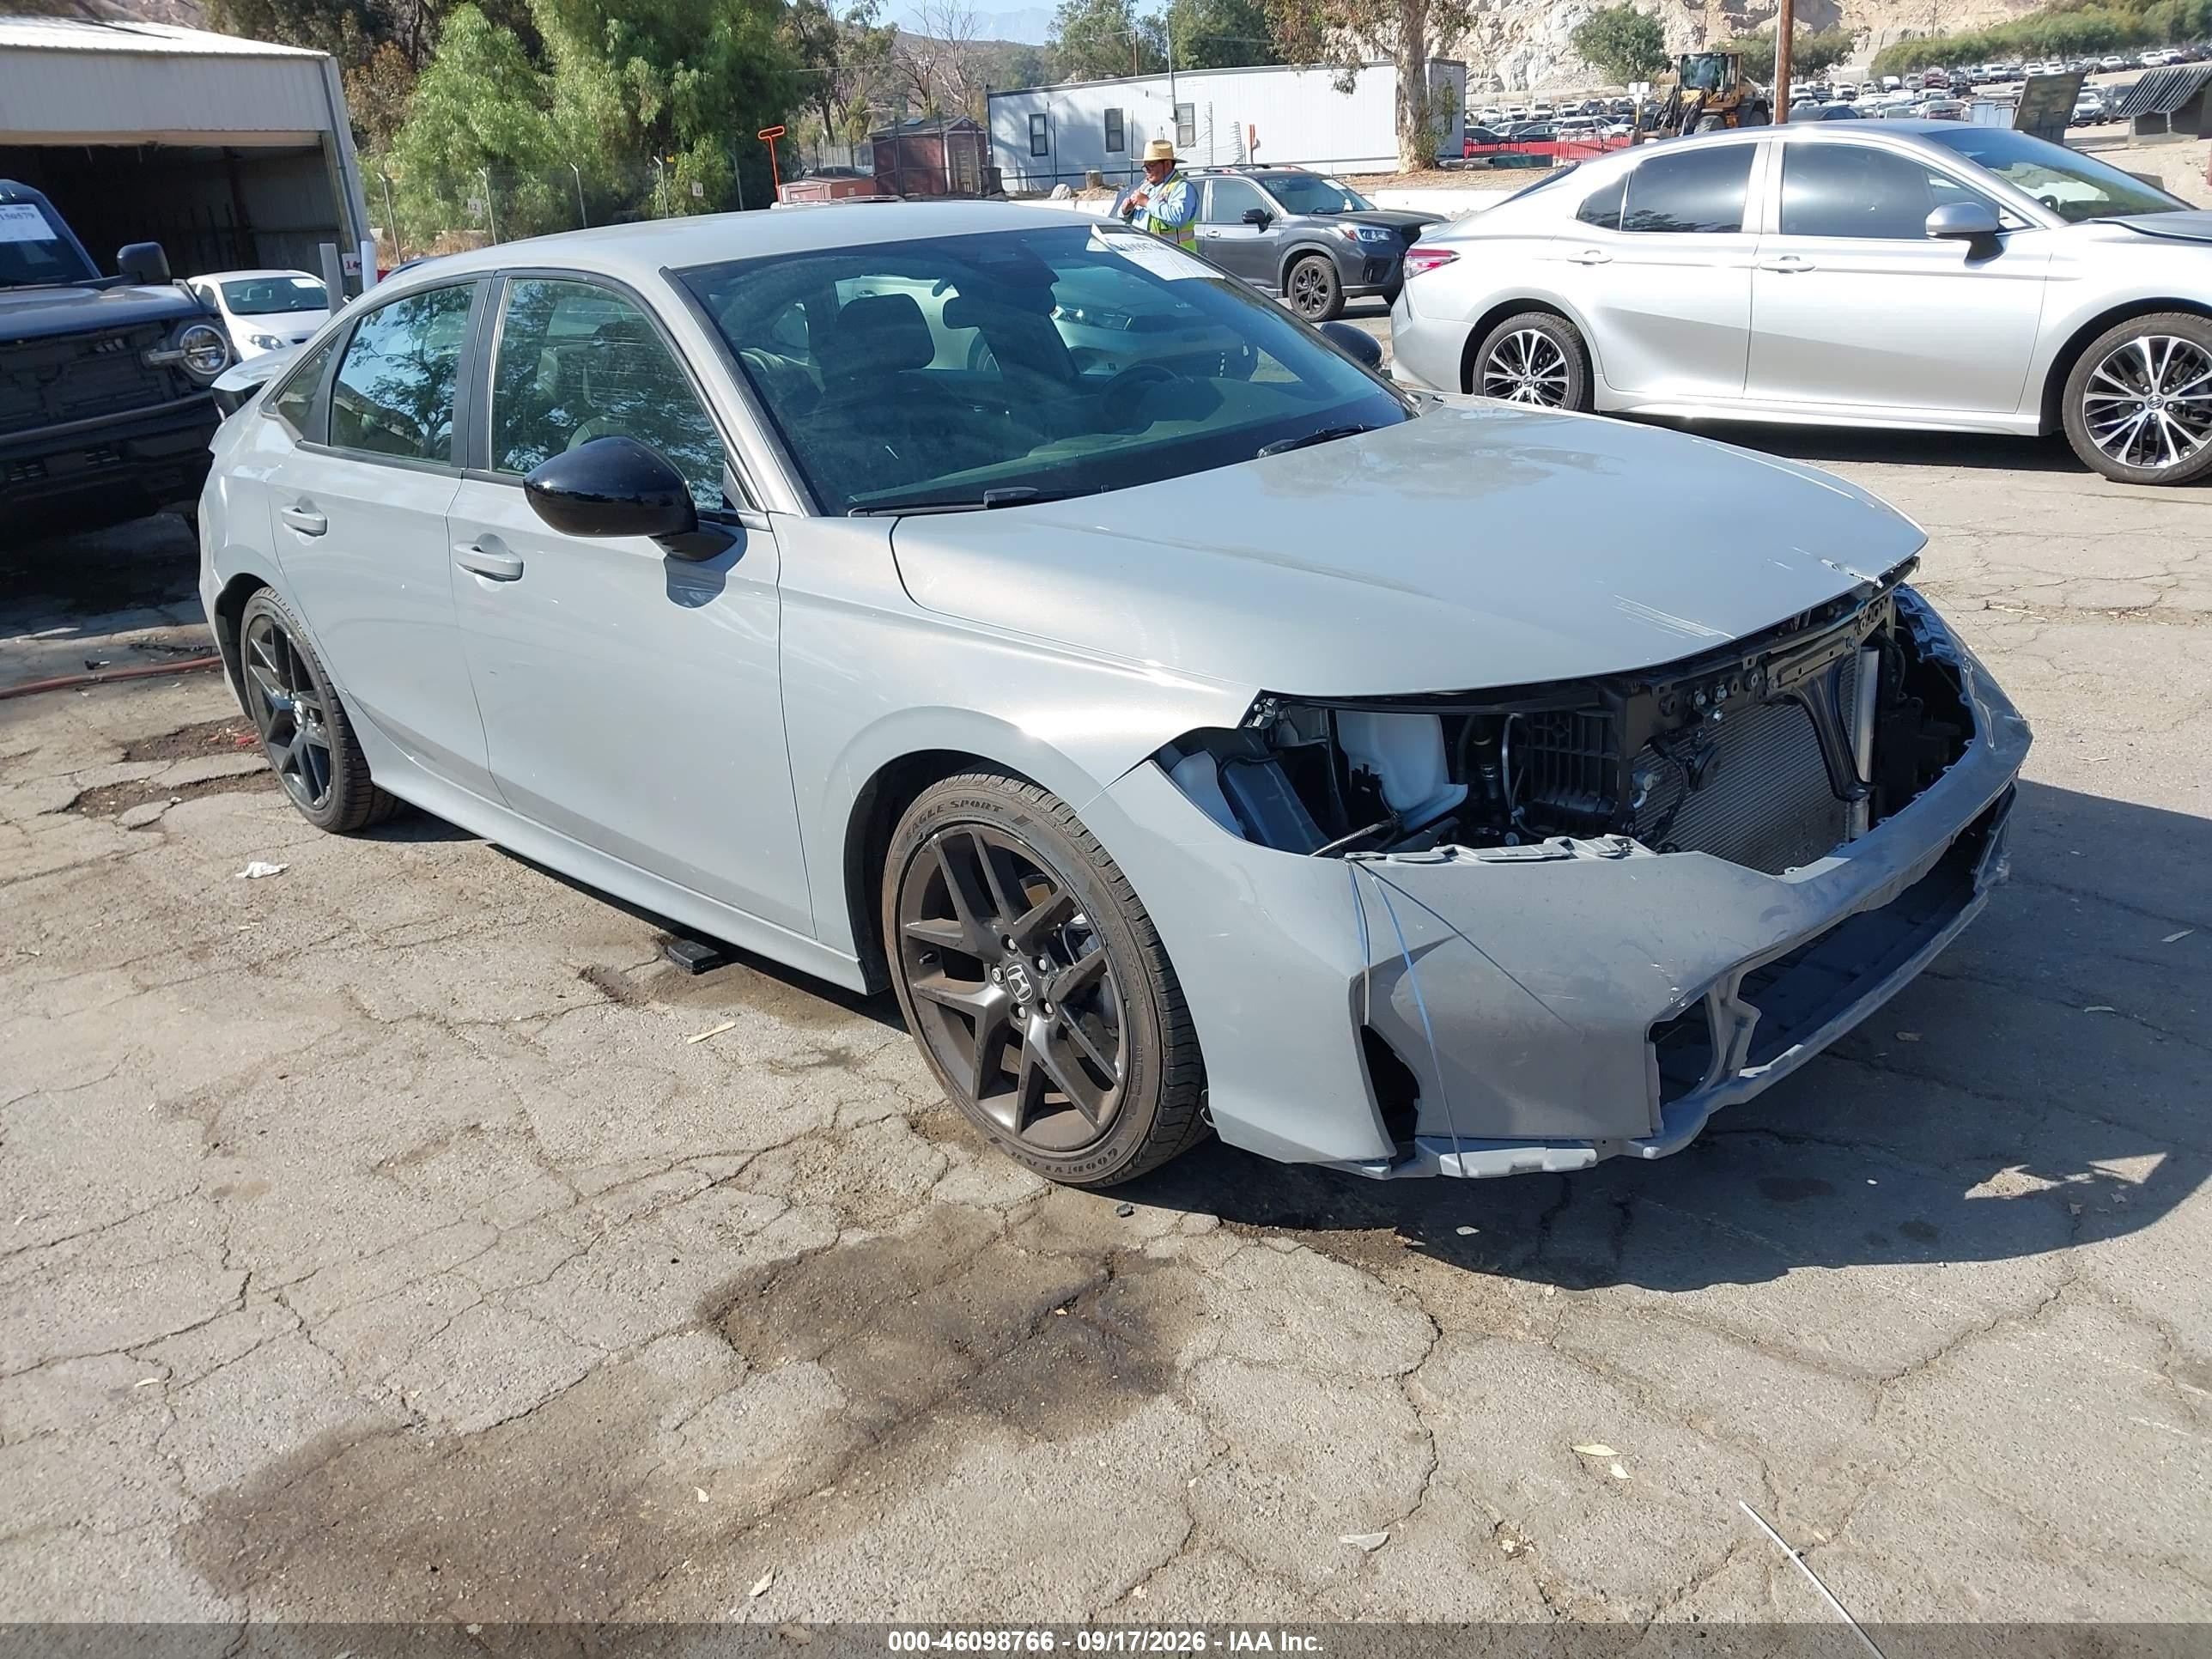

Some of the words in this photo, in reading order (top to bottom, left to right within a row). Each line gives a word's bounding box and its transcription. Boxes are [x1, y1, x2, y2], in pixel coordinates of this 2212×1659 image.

[346, 260, 359, 270] 14
[906, 803, 945, 841] EAGLE
[950, 799, 1004, 813] SPORT
